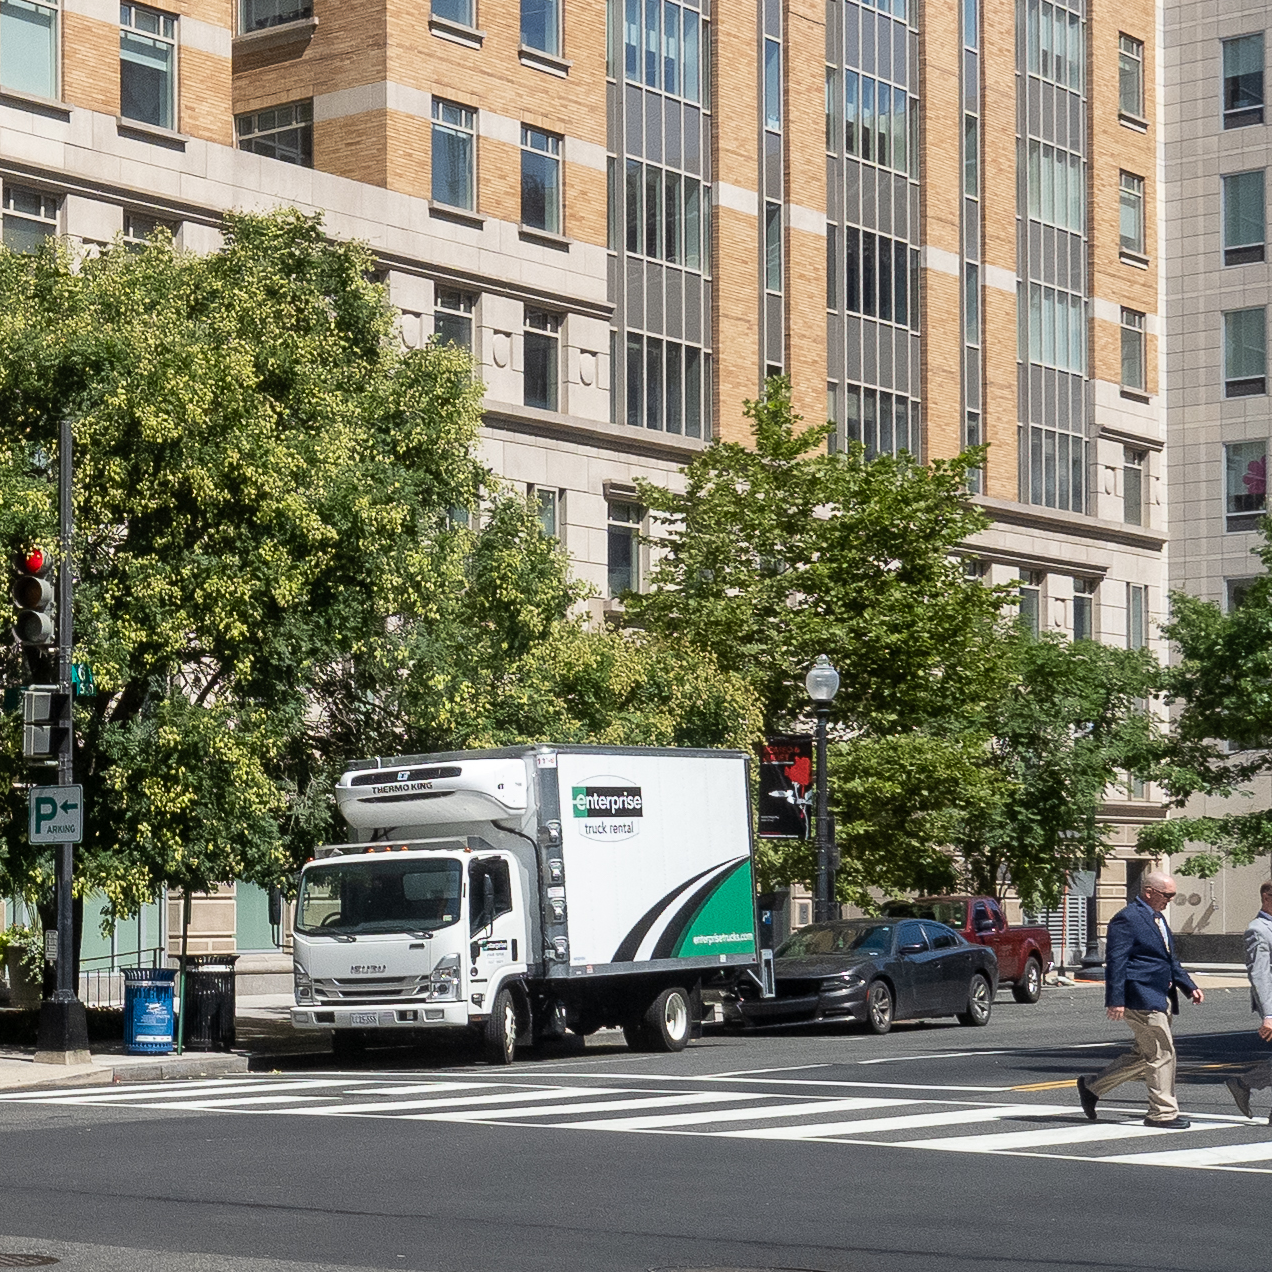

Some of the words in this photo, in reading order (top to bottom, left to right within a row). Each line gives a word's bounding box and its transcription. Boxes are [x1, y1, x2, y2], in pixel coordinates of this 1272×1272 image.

[371, 784, 410, 794] THERMO
[411, 781, 433, 791] KING
[576, 791, 642, 814] enterprise
[585, 821, 607, 834] truck
[609, 821, 634, 834] rental
[350, 965, 387, 974] ISUZU
